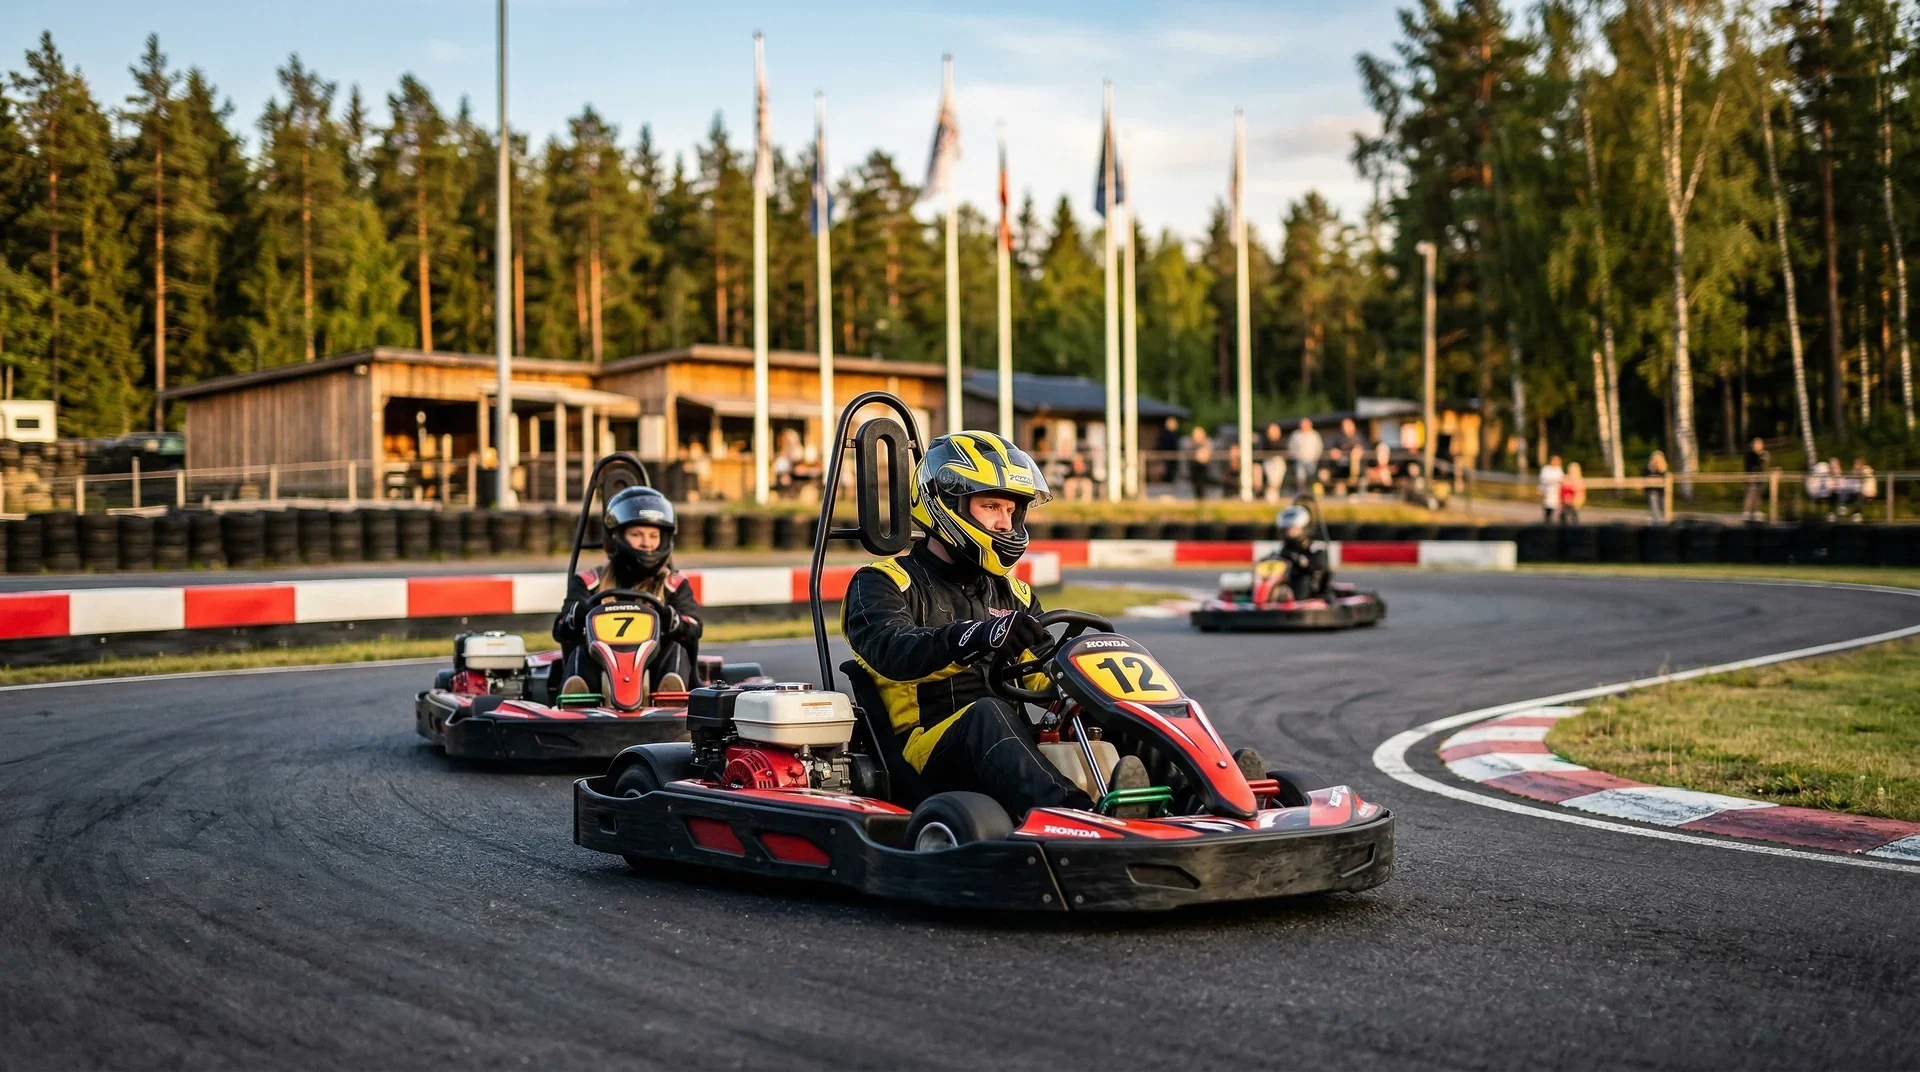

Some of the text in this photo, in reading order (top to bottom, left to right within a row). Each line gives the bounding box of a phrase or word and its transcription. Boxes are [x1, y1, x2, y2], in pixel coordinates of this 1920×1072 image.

[613, 617, 634, 637] 7
[1096, 657, 1167, 694] 12
[1043, 825, 1101, 839] HONDA
